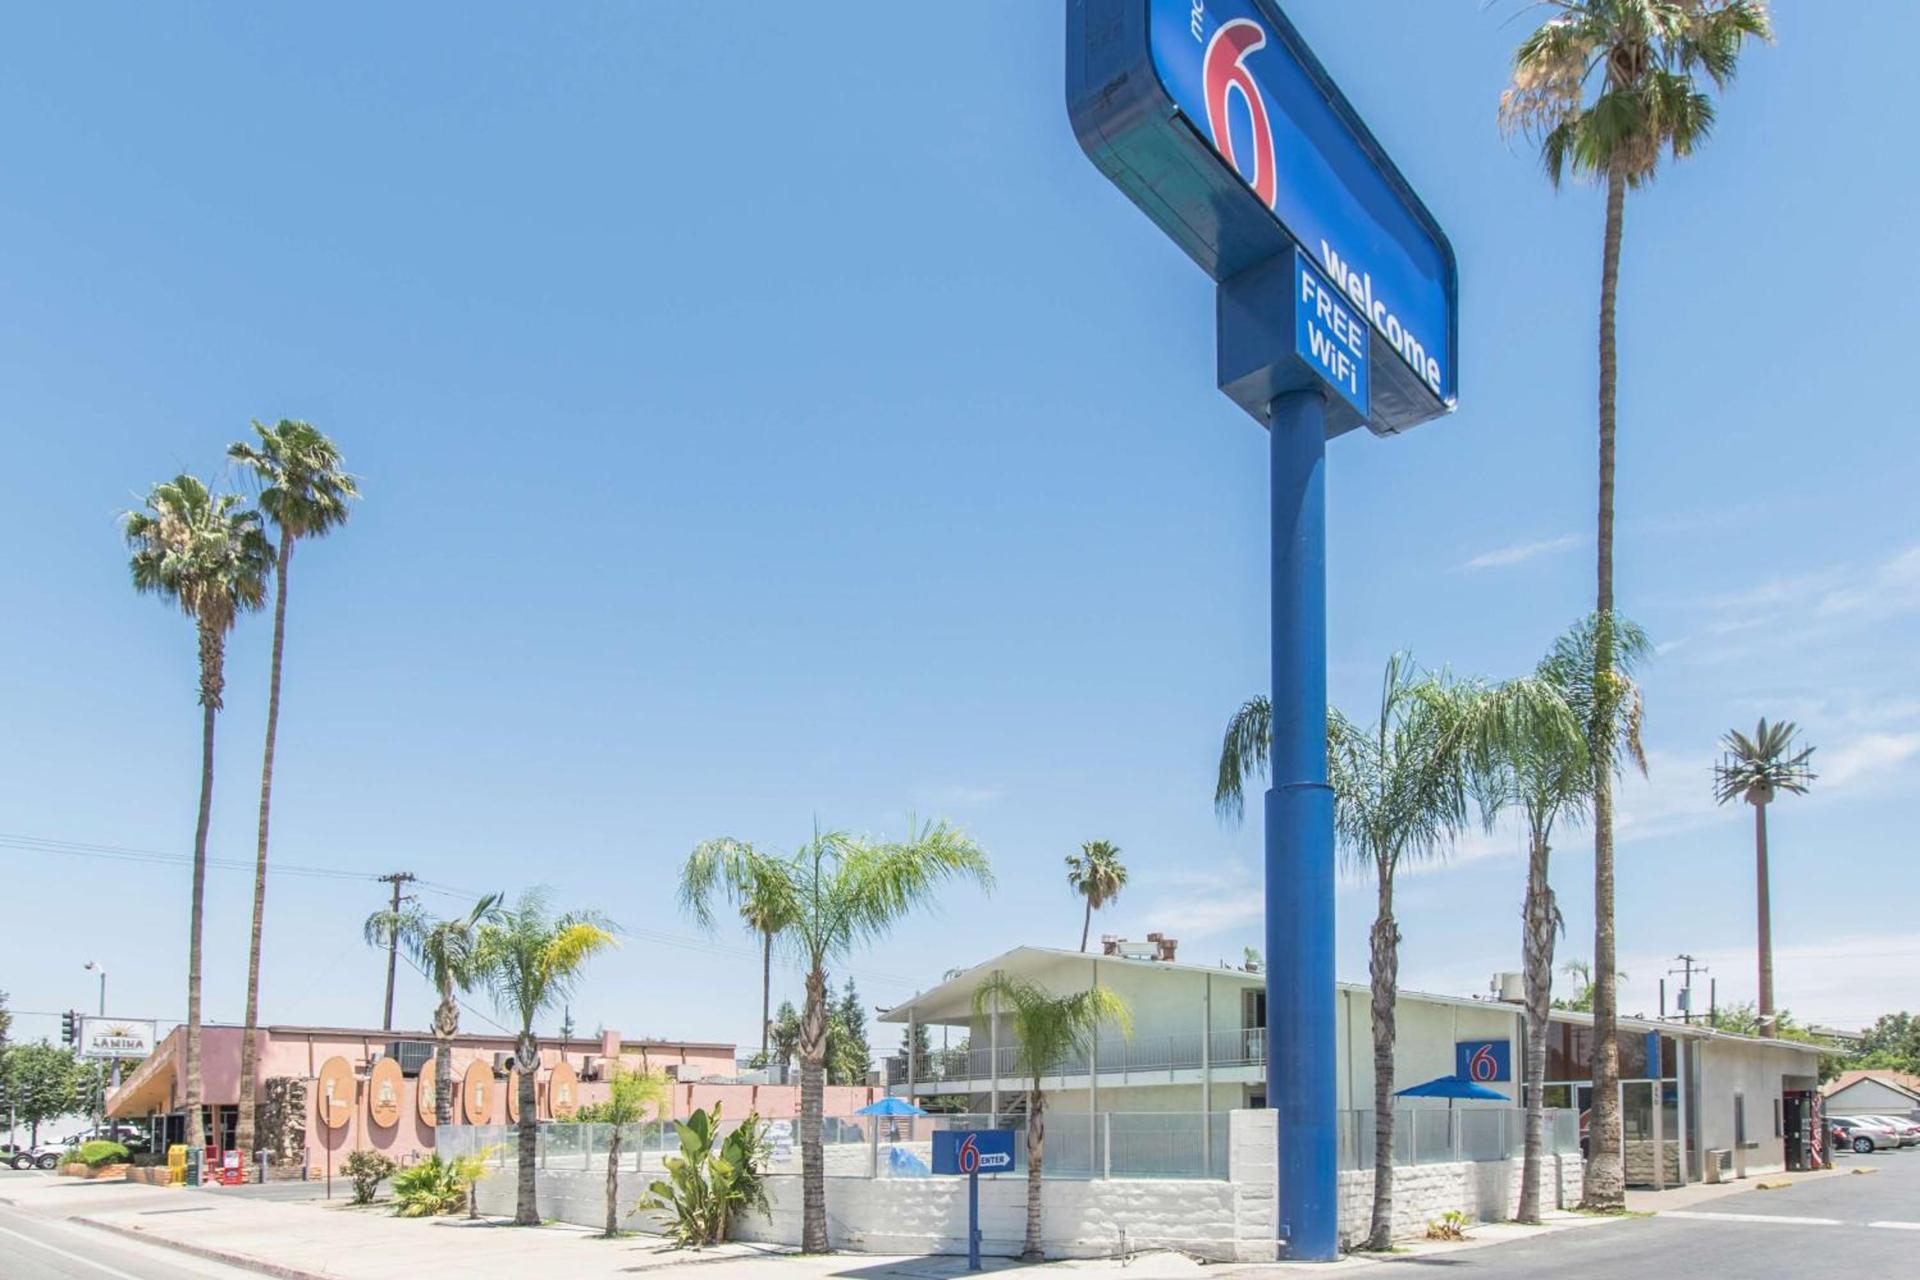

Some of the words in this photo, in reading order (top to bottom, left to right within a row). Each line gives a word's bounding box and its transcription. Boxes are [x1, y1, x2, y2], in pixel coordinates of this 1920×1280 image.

[1203, 17, 1277, 211] 6
[1302, 270, 1363, 359] FREE
[1307, 319, 1357, 395] WiFi
[1470, 1044, 1497, 1081] 6
[959, 1133, 980, 1173] 6
[982, 1156, 1005, 1164] ENTER
